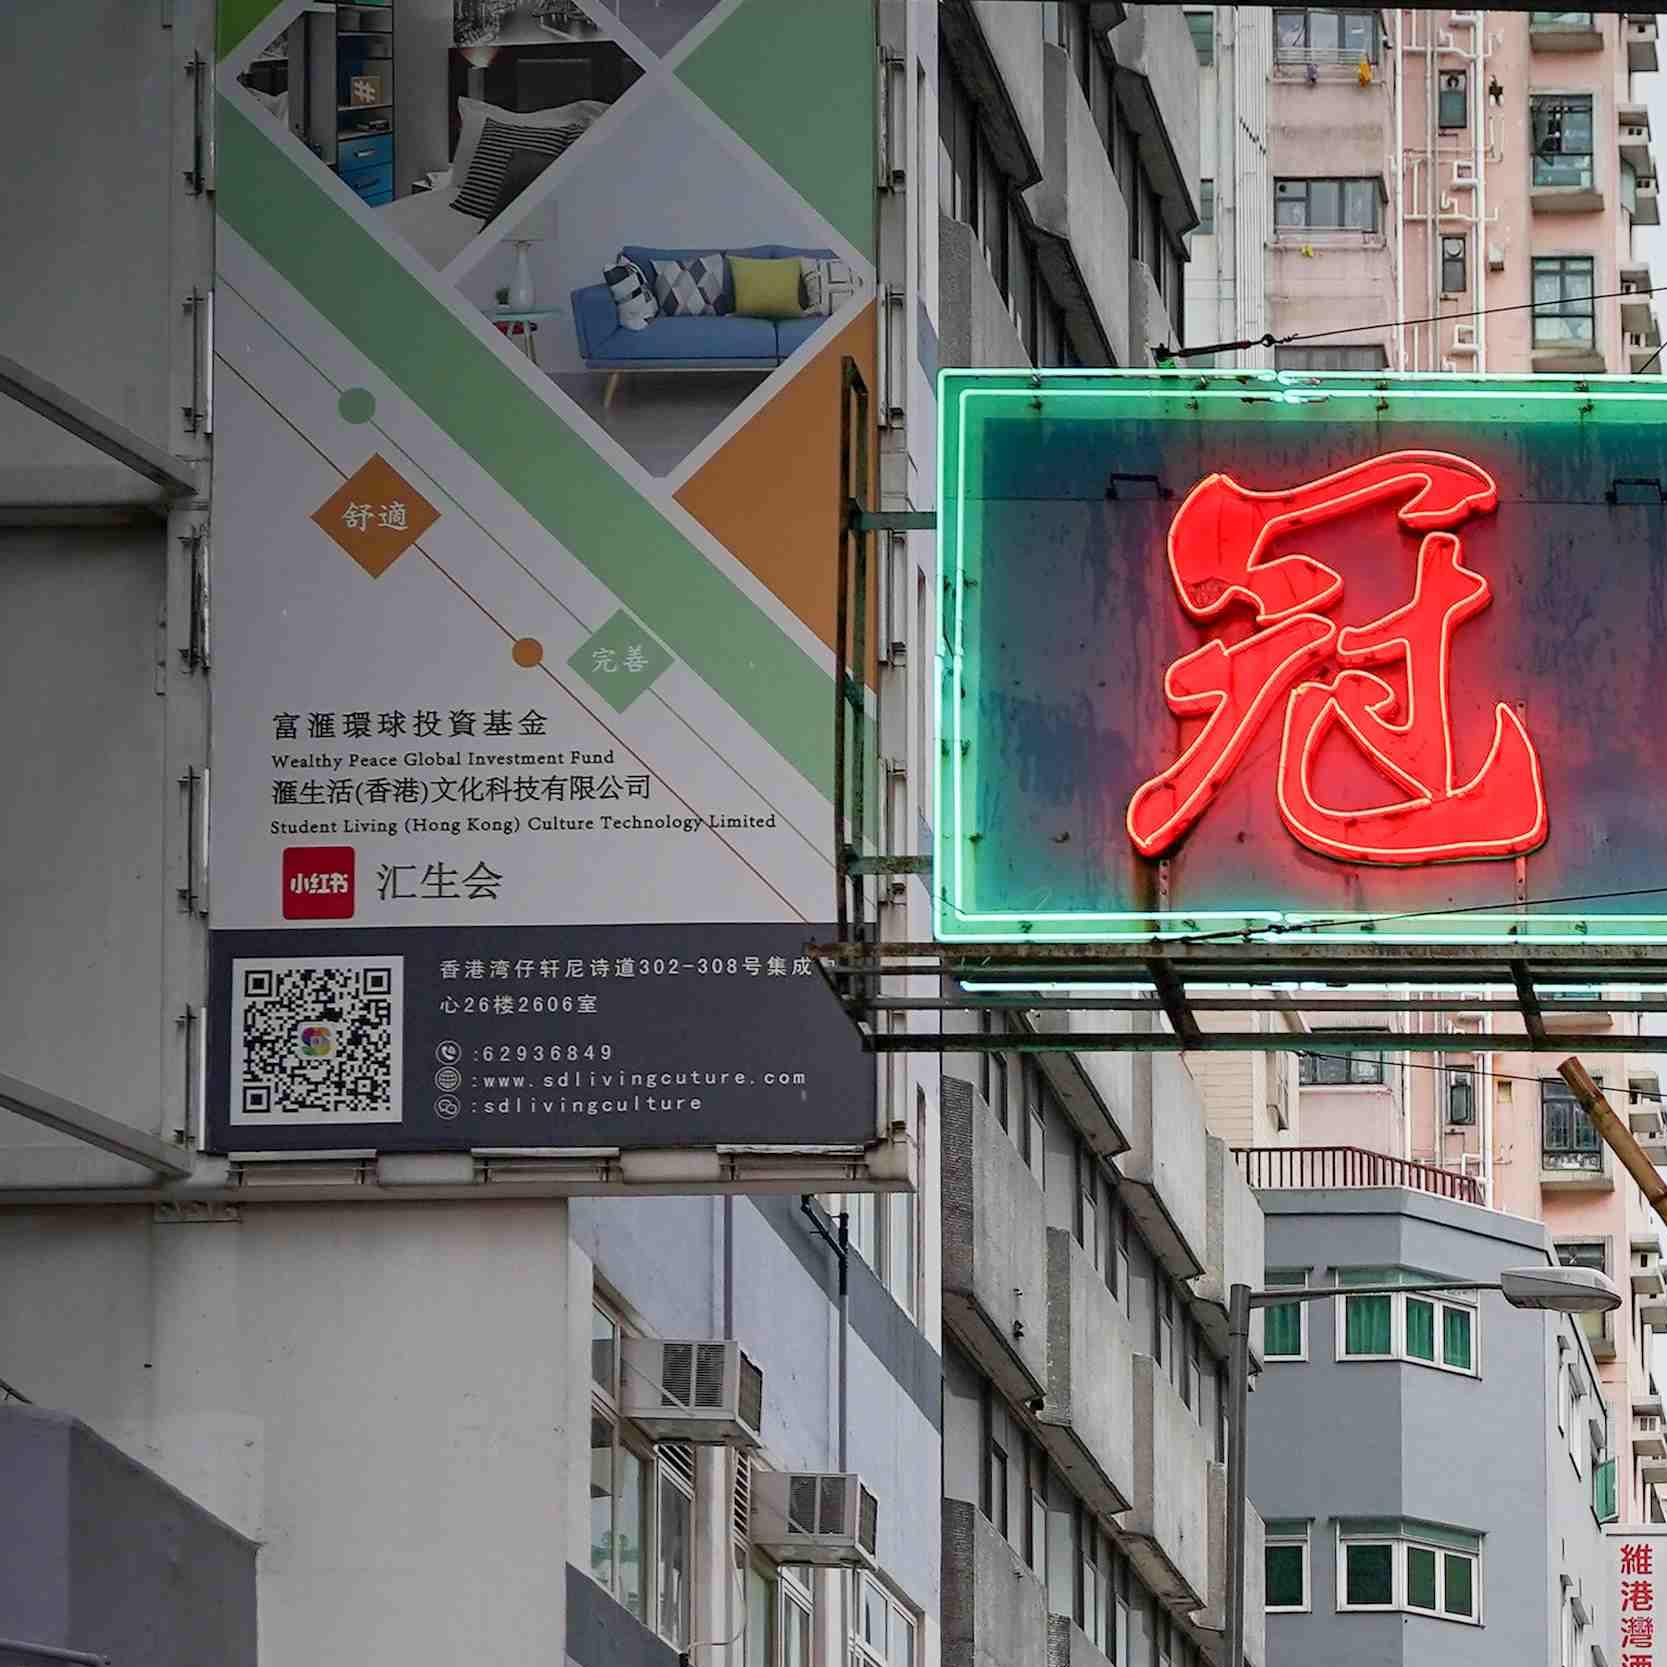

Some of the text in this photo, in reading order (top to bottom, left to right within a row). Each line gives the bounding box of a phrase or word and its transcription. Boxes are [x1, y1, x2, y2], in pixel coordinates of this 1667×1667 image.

[341, 502, 409, 531] 舒適
[591, 645, 649, 673] 完善
[271, 750, 615, 770] Wealthy Peace Global Investment Fund
[270, 813, 776, 836] Student Living (Hong Kong) Culture Technology Limited
[290, 873, 348, 895] 小红书
[376, 861, 503, 901] 汇生会
[440, 994, 598, 1015] 心26楼2606室
